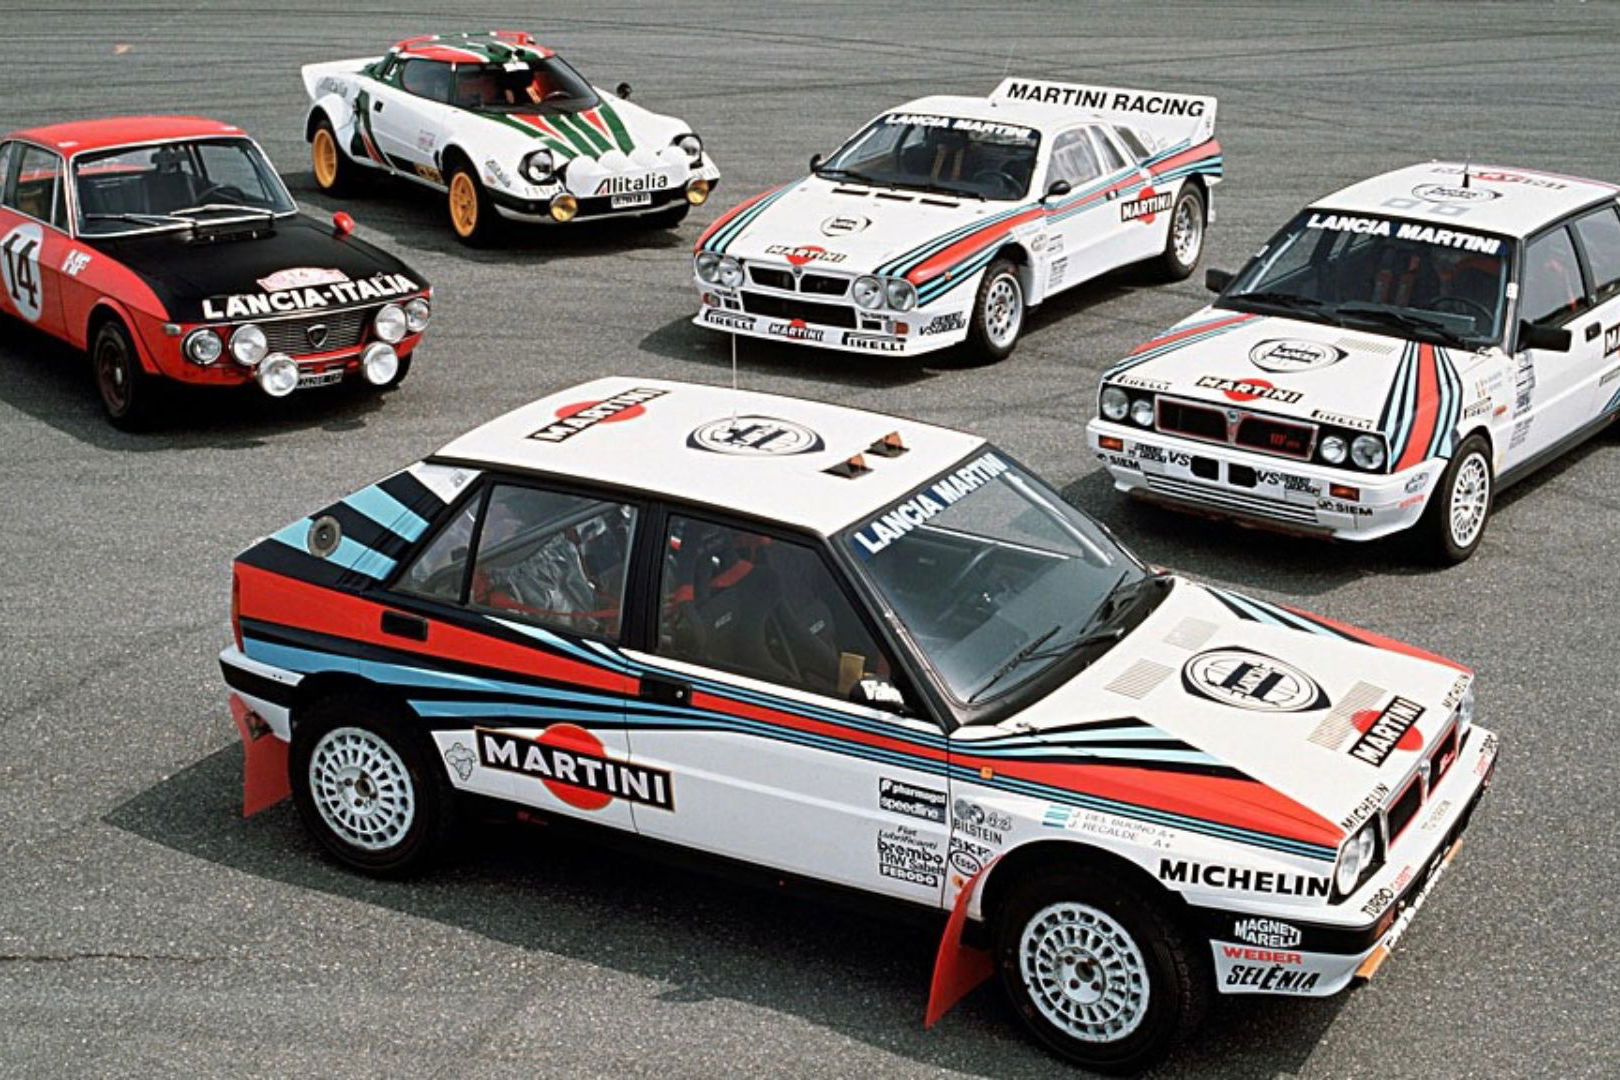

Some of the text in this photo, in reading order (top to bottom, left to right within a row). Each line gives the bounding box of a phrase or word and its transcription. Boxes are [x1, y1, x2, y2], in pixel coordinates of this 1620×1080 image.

[1006, 83, 1206, 117] MARTINI RACING
[884, 113, 1033, 138] LANCIA MARTINI
[594, 173, 668, 196] Alitalia
[1122, 193, 1173, 221] MARTINI
[1306, 213, 1502, 255] LANCIA MARTINI
[3, 232, 39, 310] 14
[202, 273, 419, 319] LANCIA-ITALIA
[704, 308, 757, 330] PIRELLI
[768, 322, 826, 342] MARTINI
[842, 331, 908, 352] PIRELLI
[1197, 377, 1302, 404] MARTINI
[530, 387, 668, 441] MARTINI
[853, 452, 1009, 554] LANCIA MARTINI
[1335, 503, 1374, 516] SIEM
[1352, 698, 1424, 766] MARTINI
[484, 736, 668, 804] MARTINI
[1341, 782, 1390, 831] MICHELIN
[952, 817, 1002, 845] BILSTEIN
[878, 838, 943, 864] brembo
[882, 865, 936, 886] FERODO
[1159, 858, 1330, 897] MICHELIN
[1223, 946, 1302, 965] WEBER
